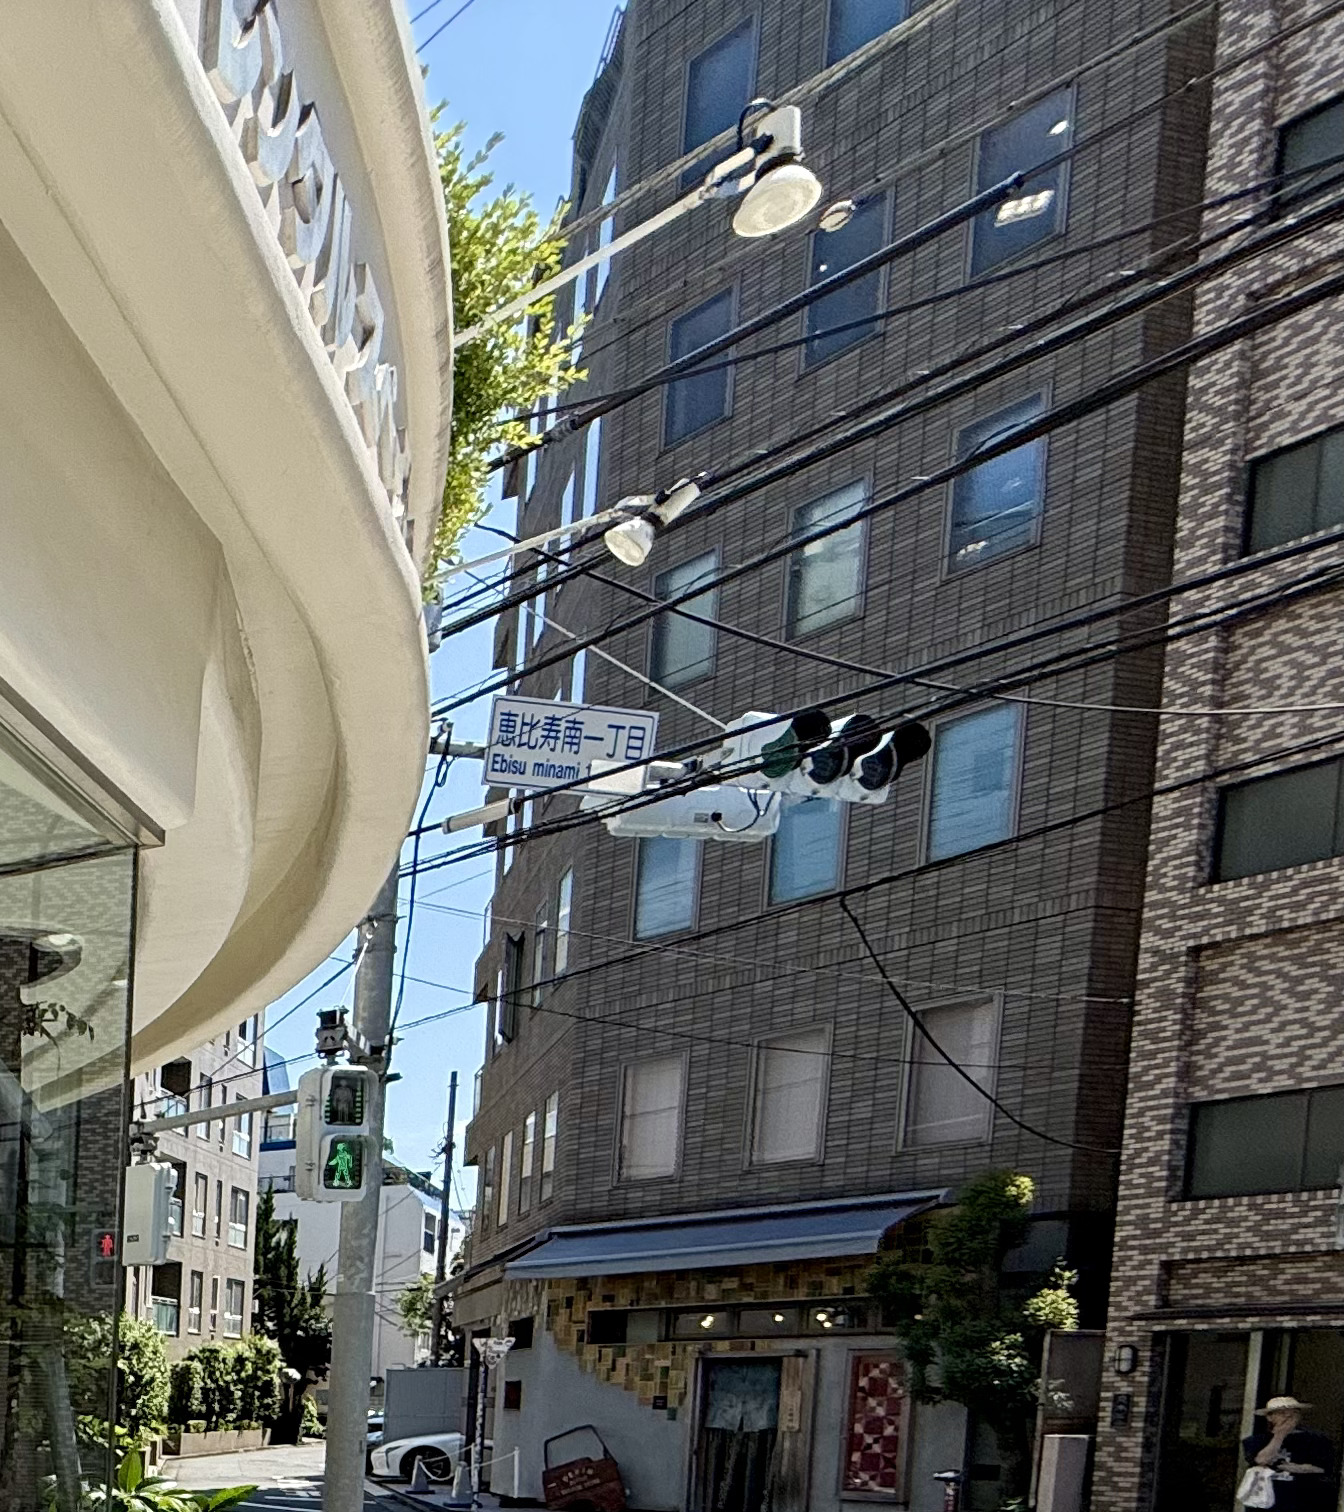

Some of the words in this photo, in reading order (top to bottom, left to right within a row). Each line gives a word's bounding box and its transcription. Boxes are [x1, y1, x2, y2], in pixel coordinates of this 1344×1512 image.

[496, 709, 646, 761] 恵比寿南一丁目
[491, 754, 527, 775] Ebisu
[532, 758, 581, 780] minami
